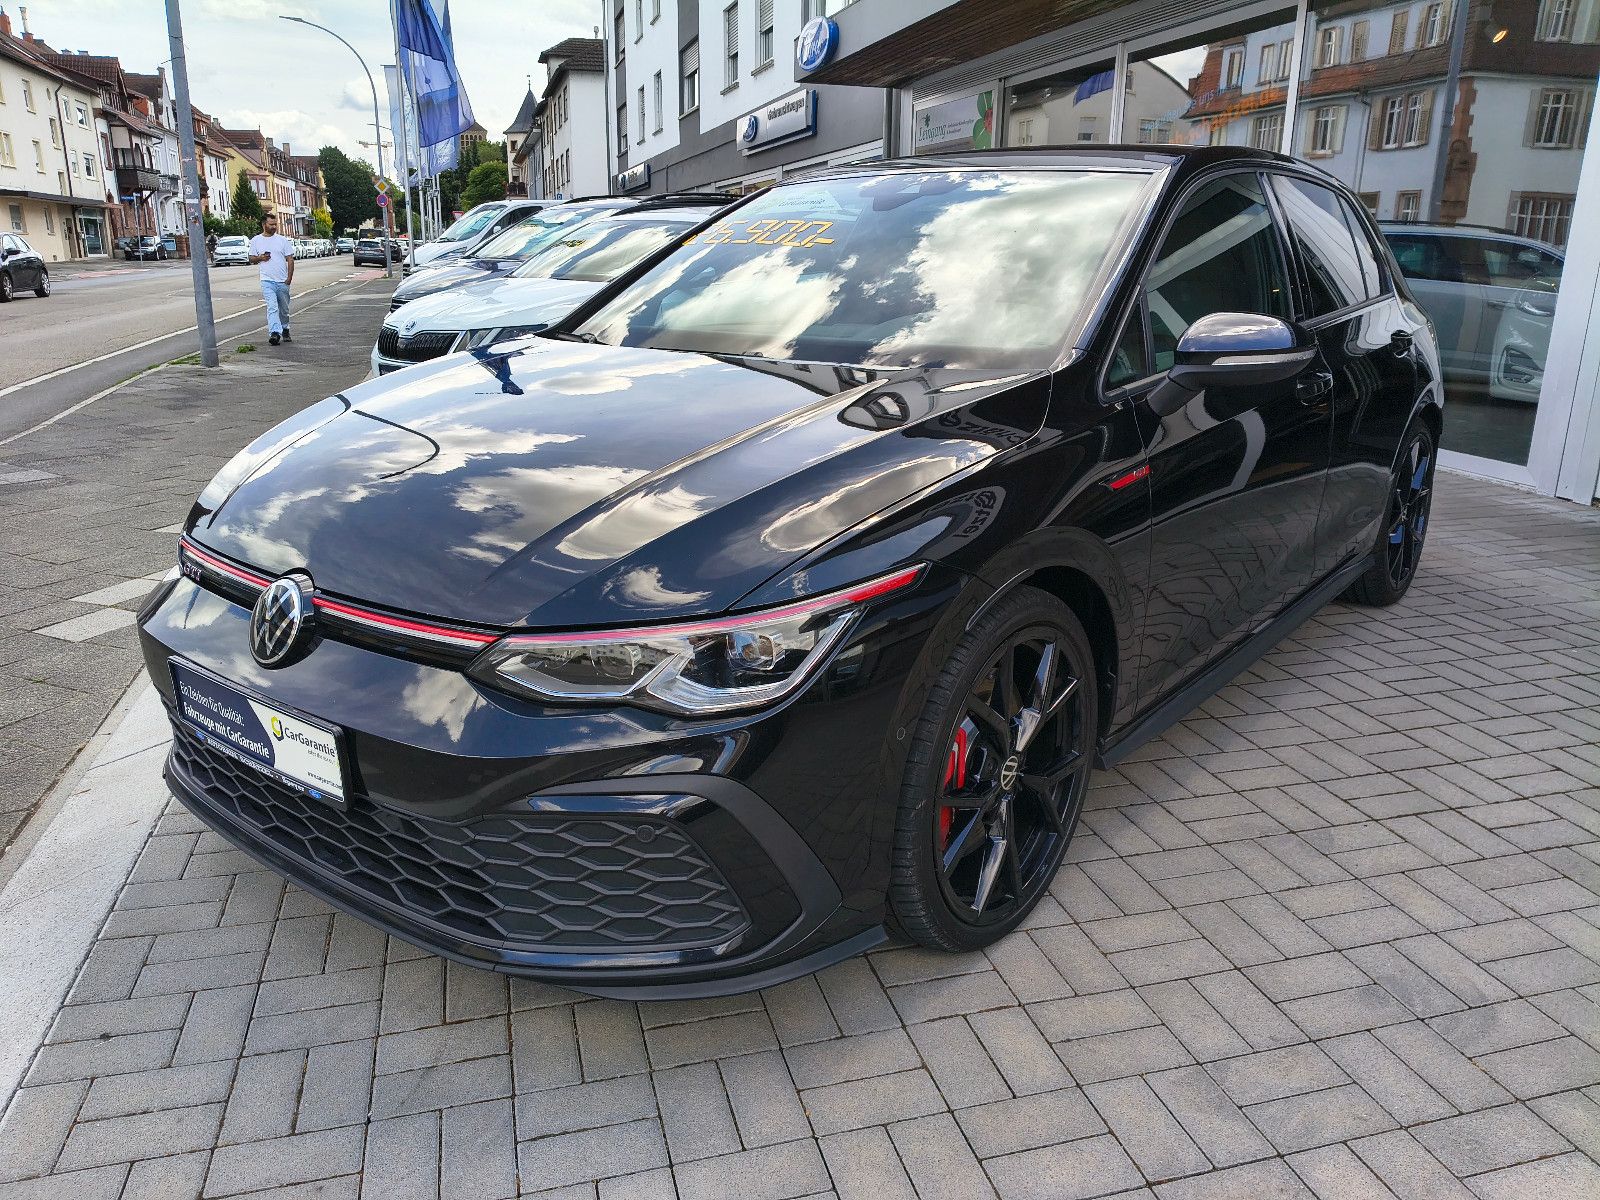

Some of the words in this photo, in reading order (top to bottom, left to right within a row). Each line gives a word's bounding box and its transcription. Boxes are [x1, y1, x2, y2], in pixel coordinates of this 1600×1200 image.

[184, 702, 215, 731] Fahrzeuge
[215, 722, 227, 738] mit
[227, 727, 270, 759] CarGarantie
[284, 726, 336, 758] CarGarantie
